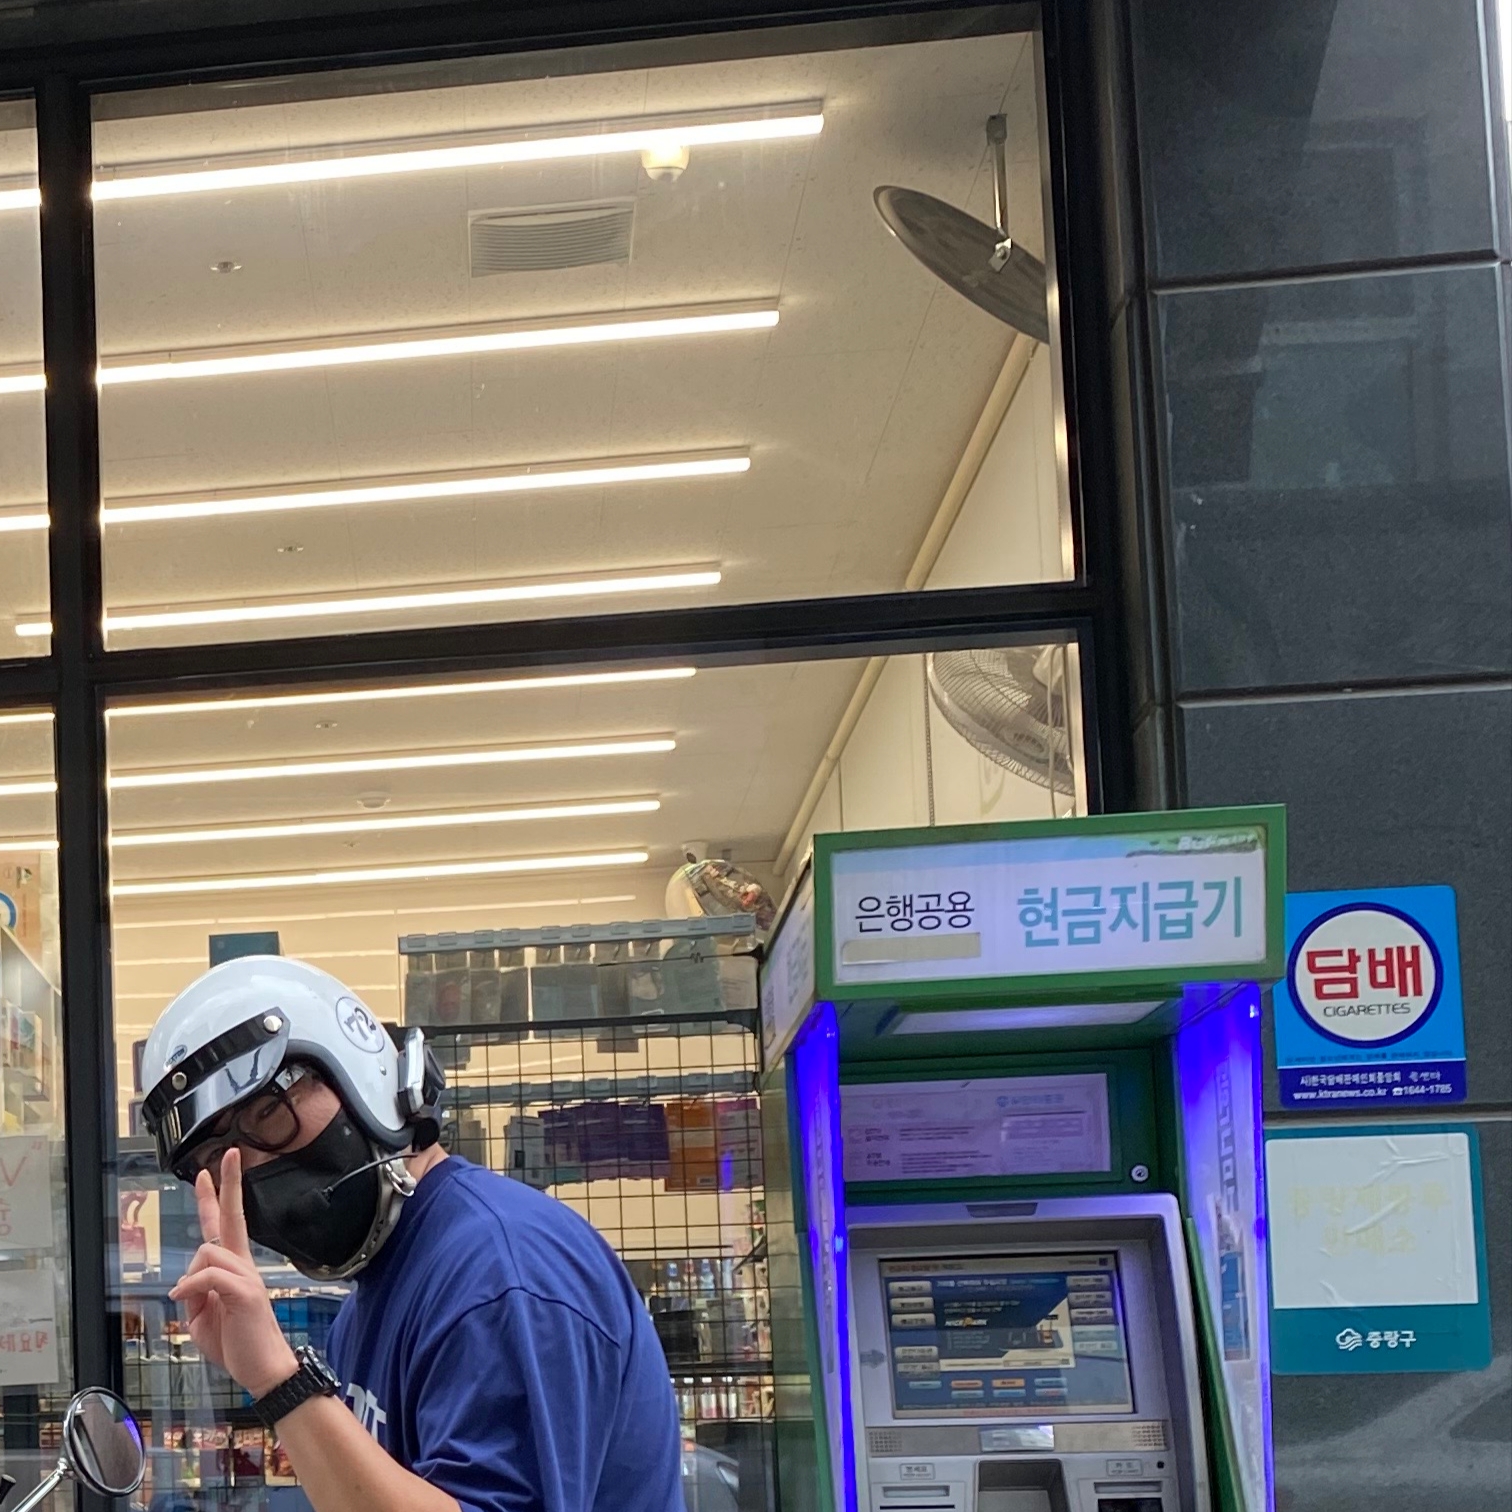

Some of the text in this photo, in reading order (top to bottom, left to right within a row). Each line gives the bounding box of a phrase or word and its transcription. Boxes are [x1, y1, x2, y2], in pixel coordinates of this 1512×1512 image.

[855, 876, 1243, 948] 은행공용 현금지급기
[1306, 945, 1423, 1001] 담배
[1323, 1002, 1412, 1018] CIGARETTES
[1365, 1330, 1417, 1348] 중랑구
